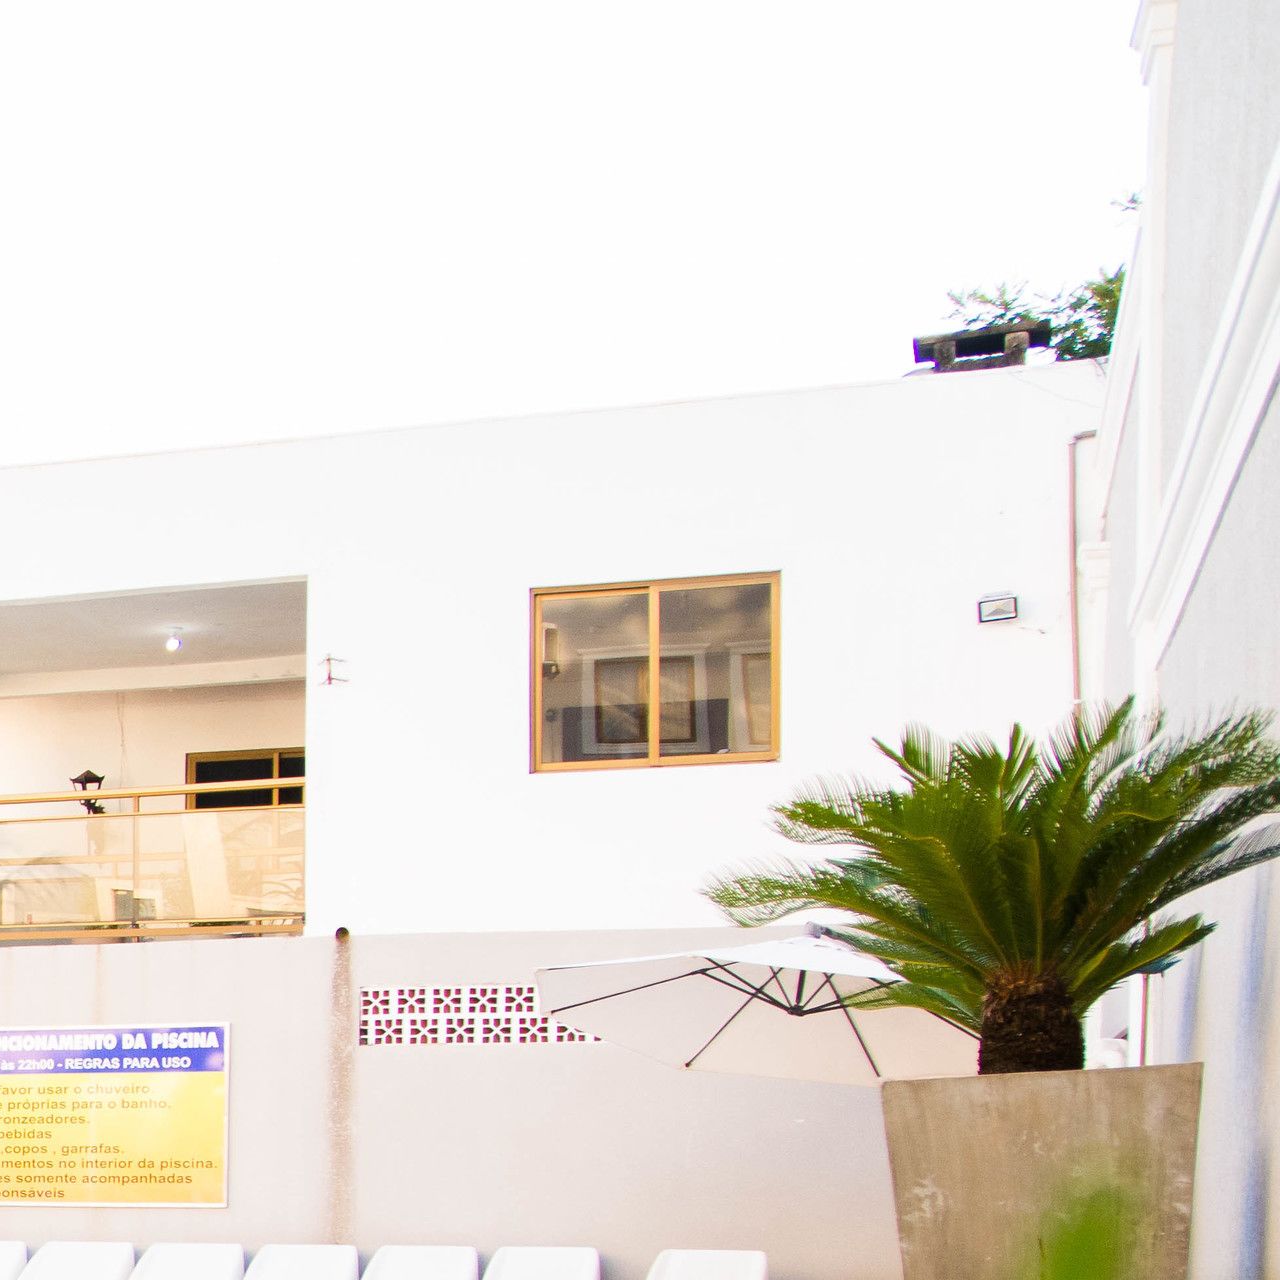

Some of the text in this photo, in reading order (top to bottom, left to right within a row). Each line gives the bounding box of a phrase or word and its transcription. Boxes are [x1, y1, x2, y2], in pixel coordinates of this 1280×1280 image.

[122, 1033, 147, 1050] DA
[151, 1031, 219, 1049] PISCINA
[18, 1059, 55, 1071] 22h00
[65, 1057, 120, 1070] REGRAS
[123, 1057, 160, 1069] PARA
[162, 1056, 191, 1069] USO
[37, 1086, 69, 1095] usar
[73, 1087, 82, 1095] o
[7, 1099, 66, 1112] próprias
[71, 1101, 103, 1112] para
[107, 1100, 117, 1109] o
[58, 1160, 77, 1169] no
[81, 1158, 132, 1169] interior
[137, 1158, 156, 1169] da
[160, 1158, 218, 1171] piscina.
[15, 1173, 77, 1184] somente
[82, 1173, 193, 1186] acompanhadas
